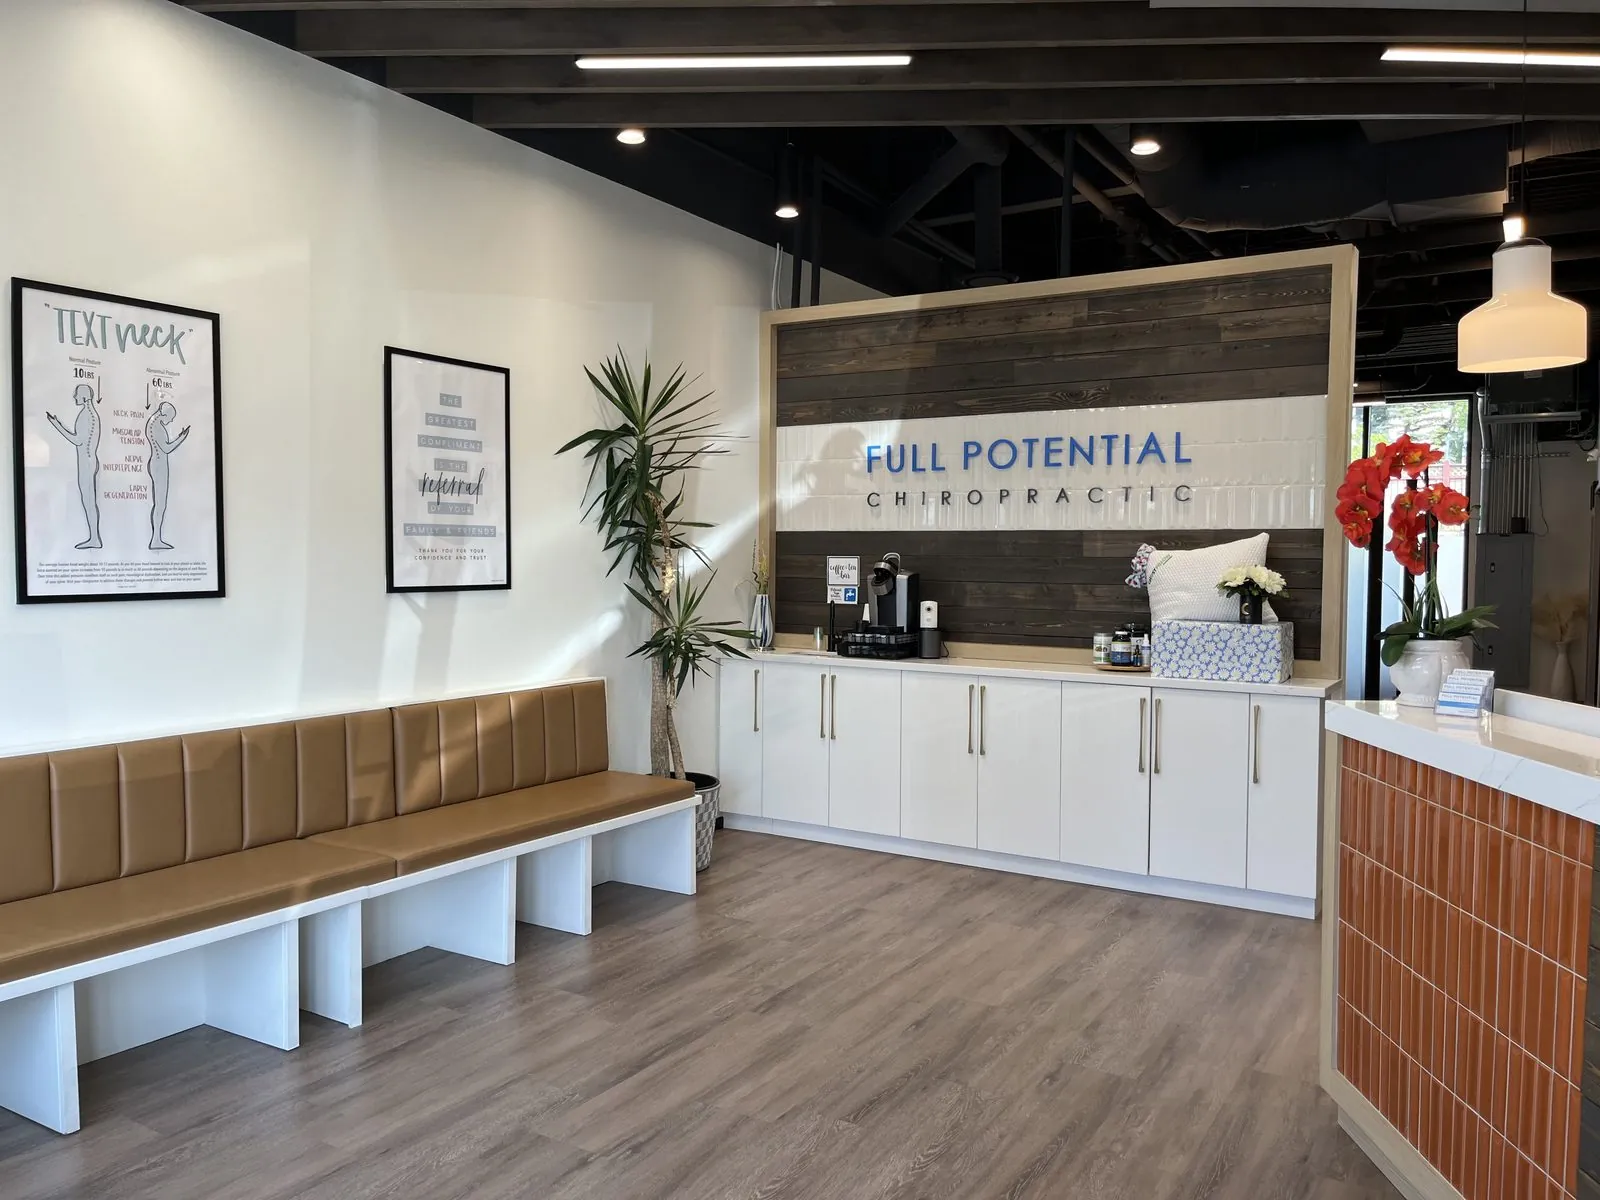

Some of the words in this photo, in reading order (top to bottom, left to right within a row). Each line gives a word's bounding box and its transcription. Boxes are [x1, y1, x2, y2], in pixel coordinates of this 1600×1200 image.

[73, 367, 84, 379] 10
[152, 377, 162, 388] 60
[442, 396, 460, 406] THE
[427, 415, 474, 428] GREATEST
[420, 436, 481, 451] COMPLIMENT
[867, 443, 946, 473] FULL
[963, 431, 1192, 470] POTENTIAL
[447, 461, 466, 472] THE
[421, 467, 485, 506] referral
[866, 485, 1194, 507] CHIROPRACTIC
[406, 525, 439, 534] FAMILY
[457, 526, 496, 535] FRIENDS
